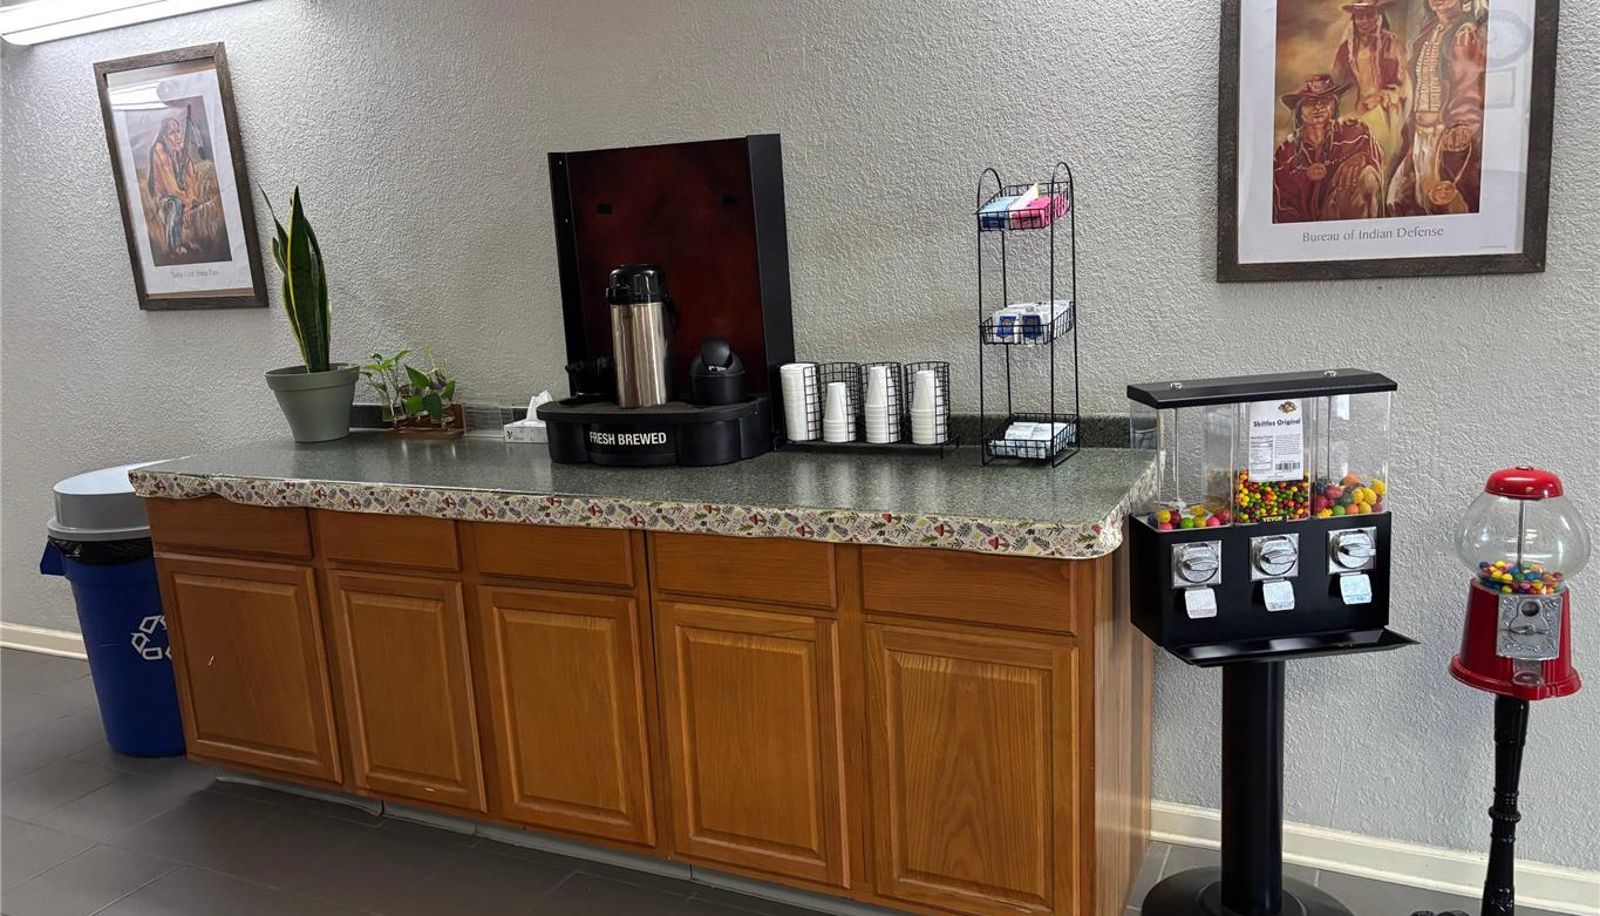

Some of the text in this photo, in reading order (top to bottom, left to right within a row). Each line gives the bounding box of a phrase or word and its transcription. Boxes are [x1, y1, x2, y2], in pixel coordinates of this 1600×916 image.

[1302, 225, 1444, 243] Bureau of Indian Defense
[1277, 418, 1301, 426] Original
[589, 431, 667, 446] FRESH BREWED
